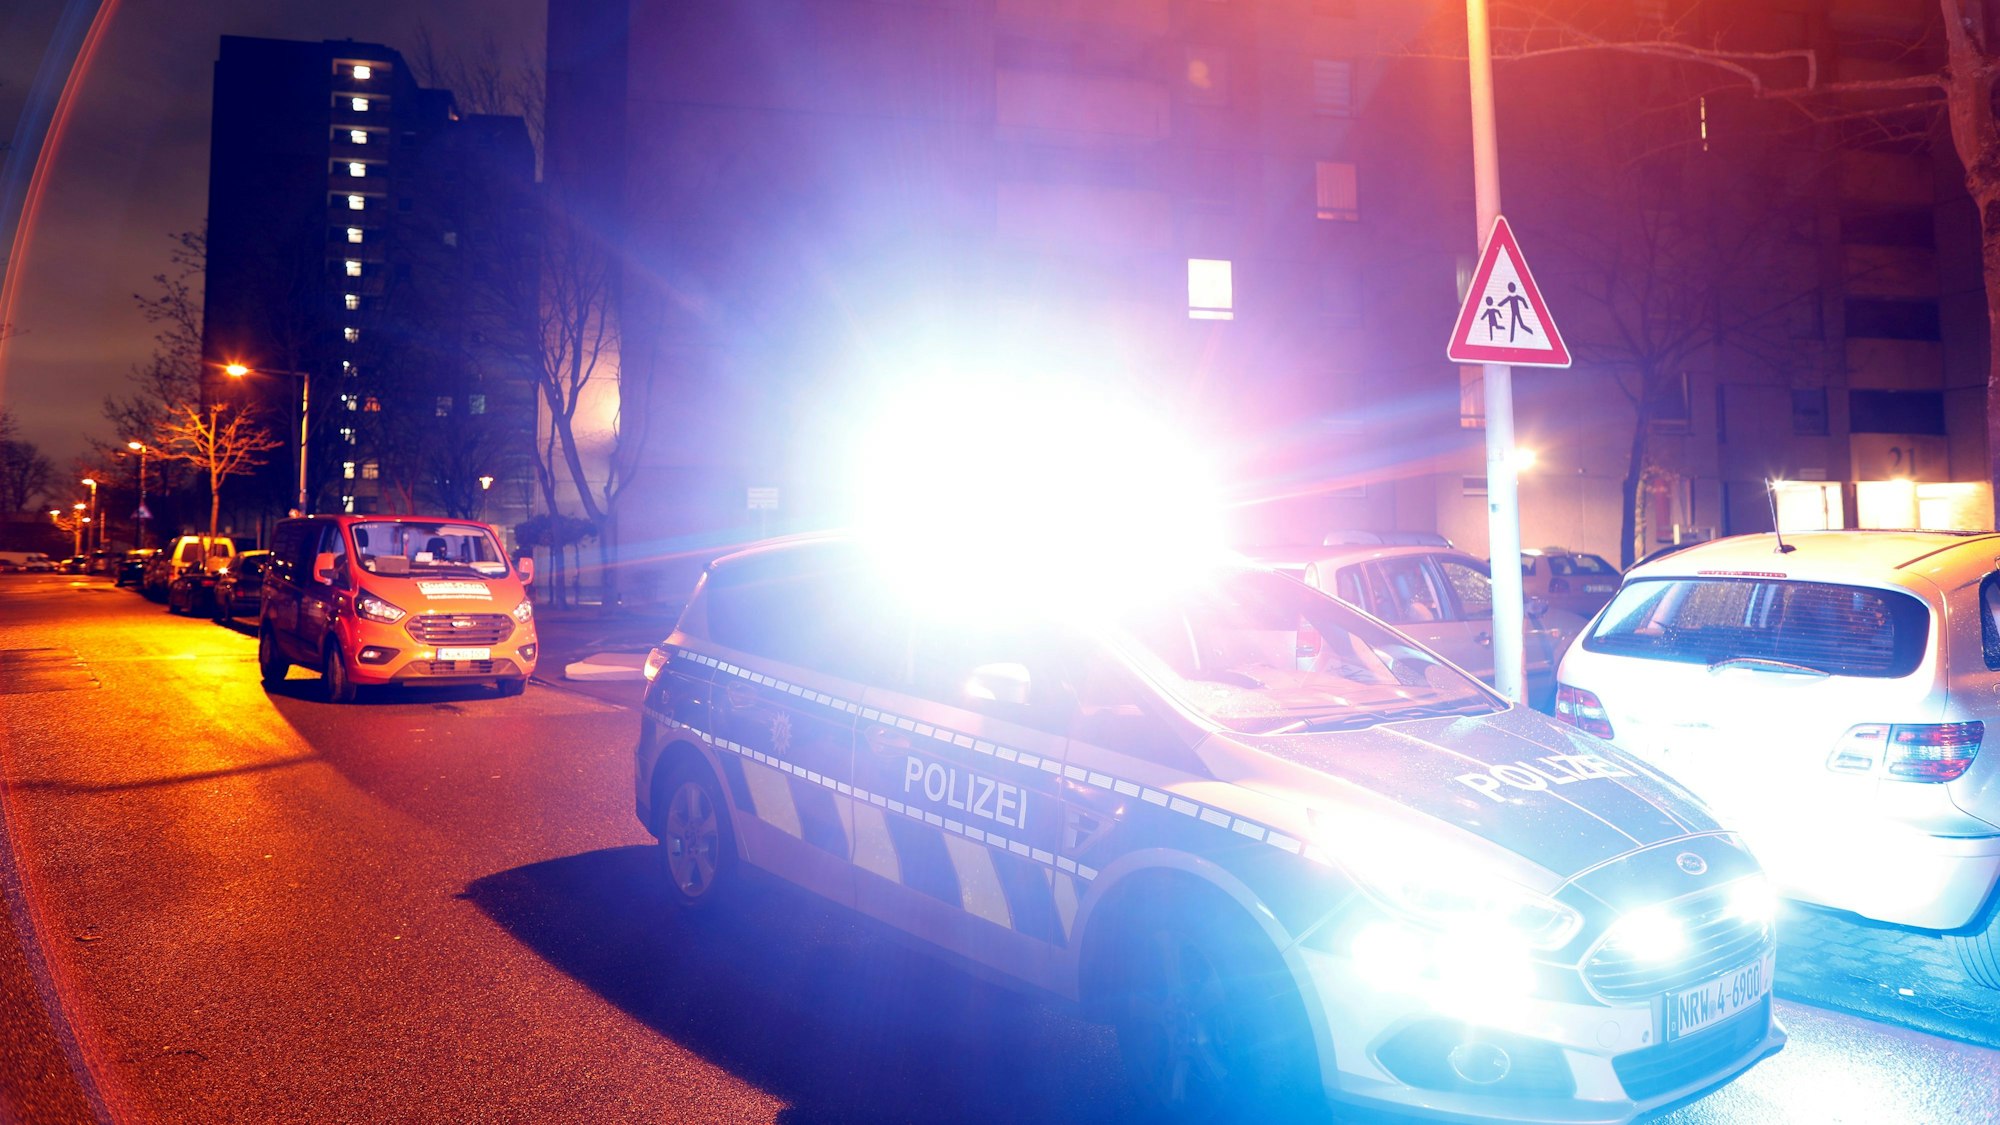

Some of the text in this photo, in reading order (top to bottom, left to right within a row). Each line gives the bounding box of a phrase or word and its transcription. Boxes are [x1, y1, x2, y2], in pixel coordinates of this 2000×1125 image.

[1888, 447, 1917, 476] 21
[904, 756, 1027, 830] POLIZEI
[1455, 754, 1639, 803] POLIZEI
[1680, 965, 1760, 1031] NRW 4-6900
